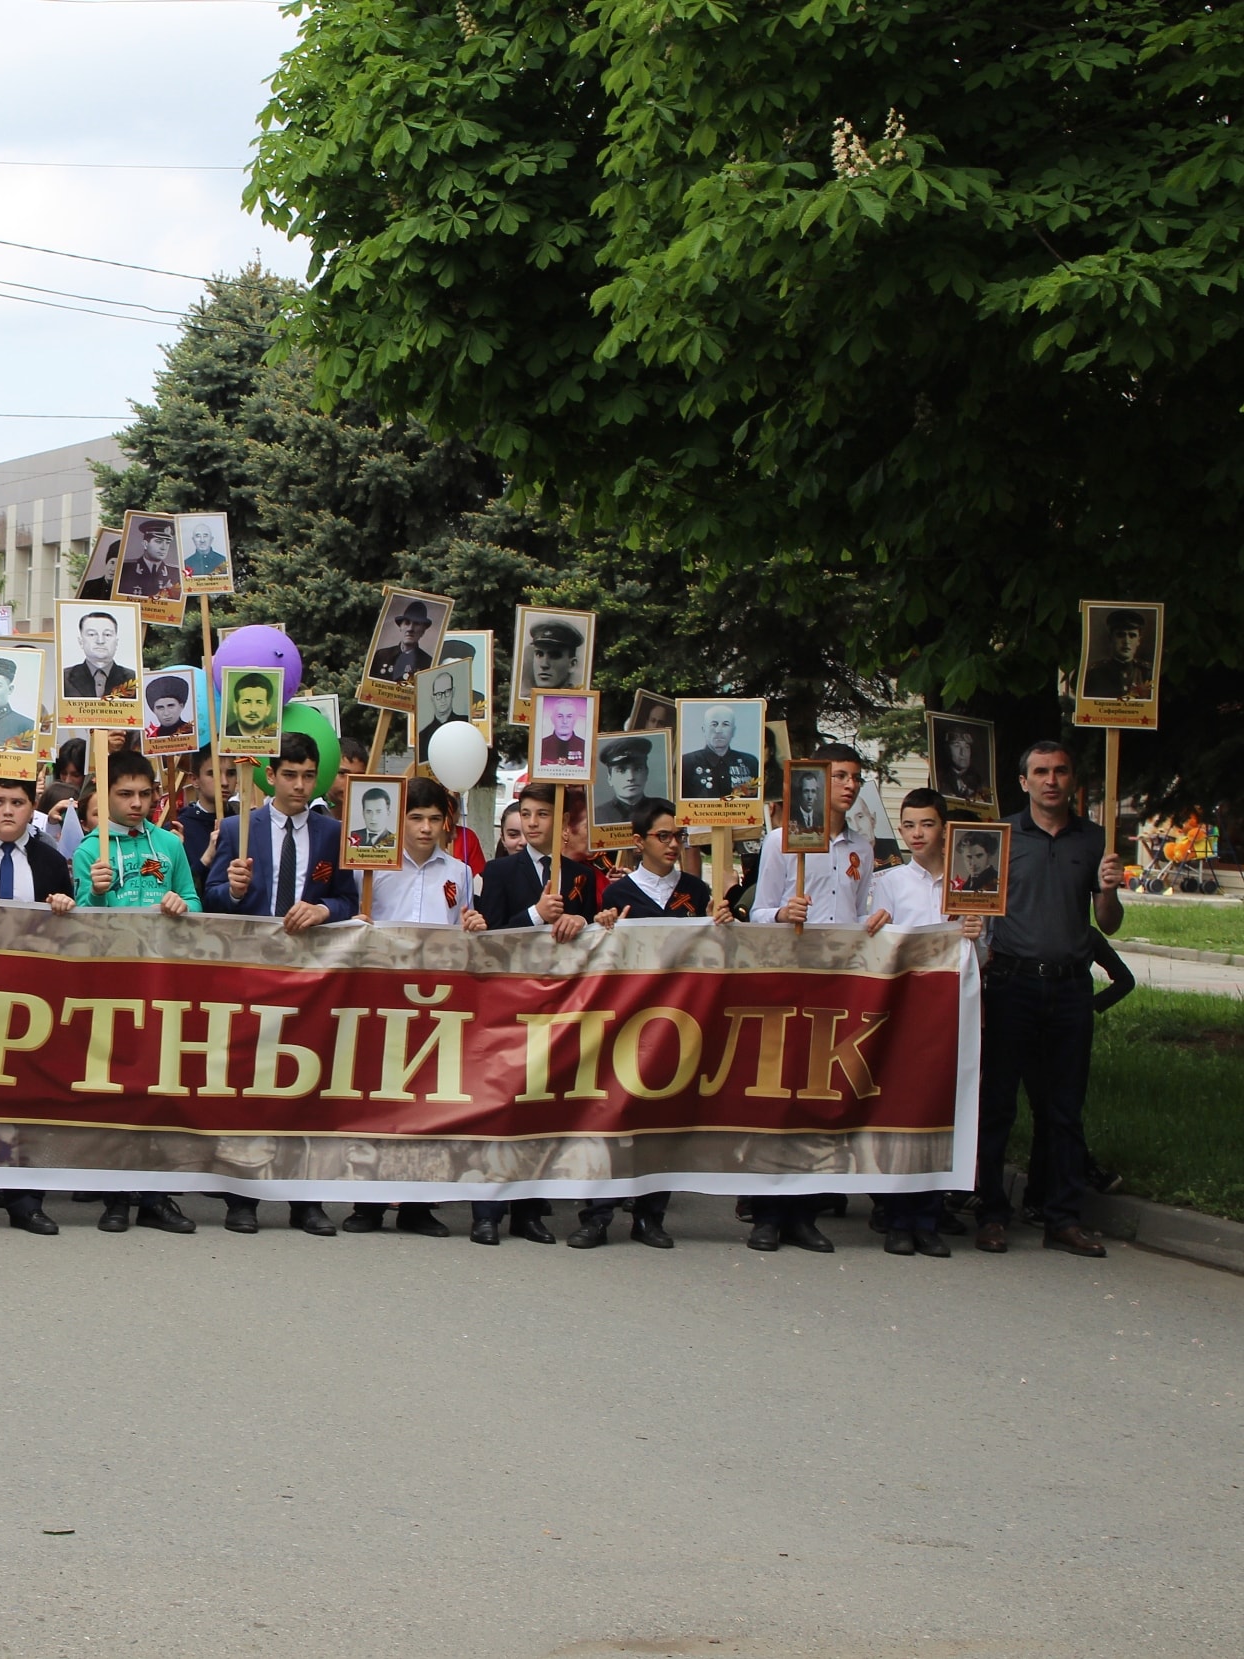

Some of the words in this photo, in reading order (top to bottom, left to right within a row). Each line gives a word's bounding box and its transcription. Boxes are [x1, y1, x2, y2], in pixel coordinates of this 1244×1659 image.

[724, 801, 750, 810] Виктор
[599, 825, 633, 833] Хаймано
[514, 1006, 893, 1103] ПОЛК
